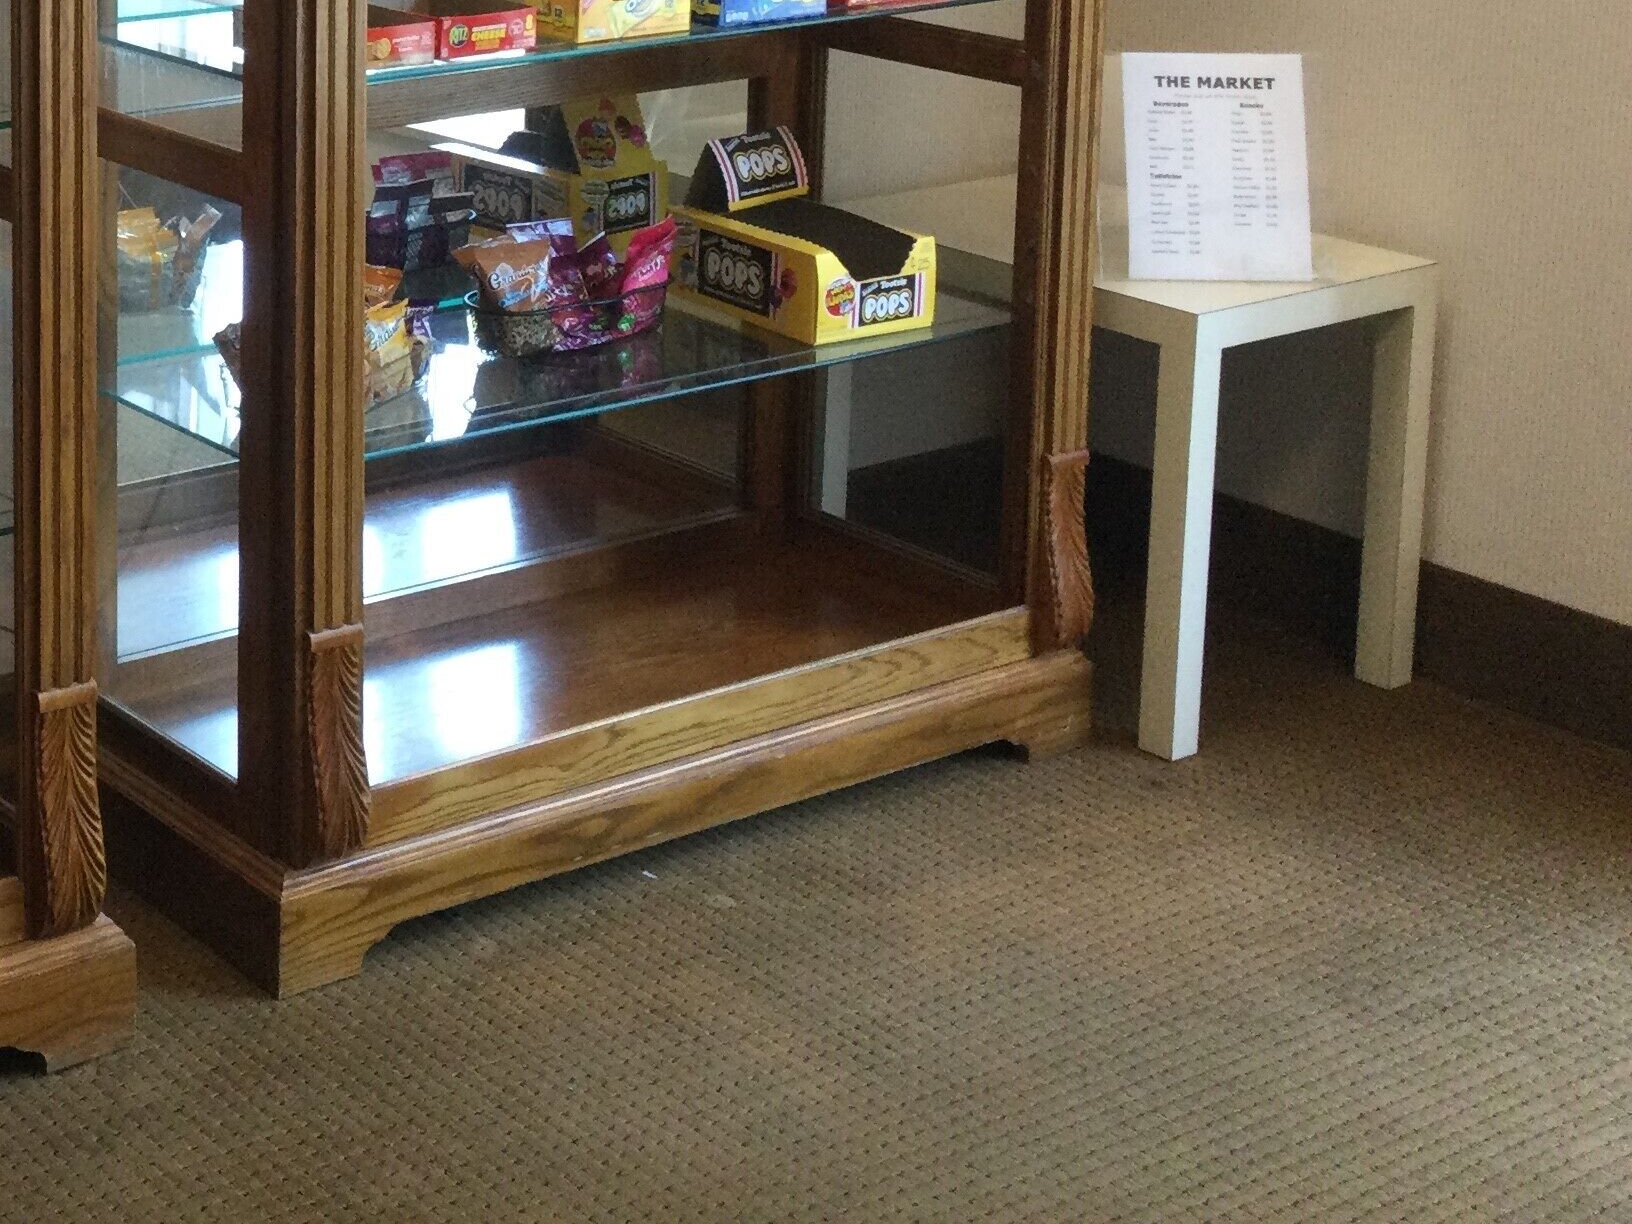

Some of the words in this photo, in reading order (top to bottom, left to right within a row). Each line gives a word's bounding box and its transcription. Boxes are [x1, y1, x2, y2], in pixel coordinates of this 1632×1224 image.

[1154, 75, 1190, 88] THE
[1197, 76, 1276, 90] MARKET
[735, 147, 789, 180] POPS
[706, 250, 763, 298] POPS
[863, 290, 910, 321] POPS
